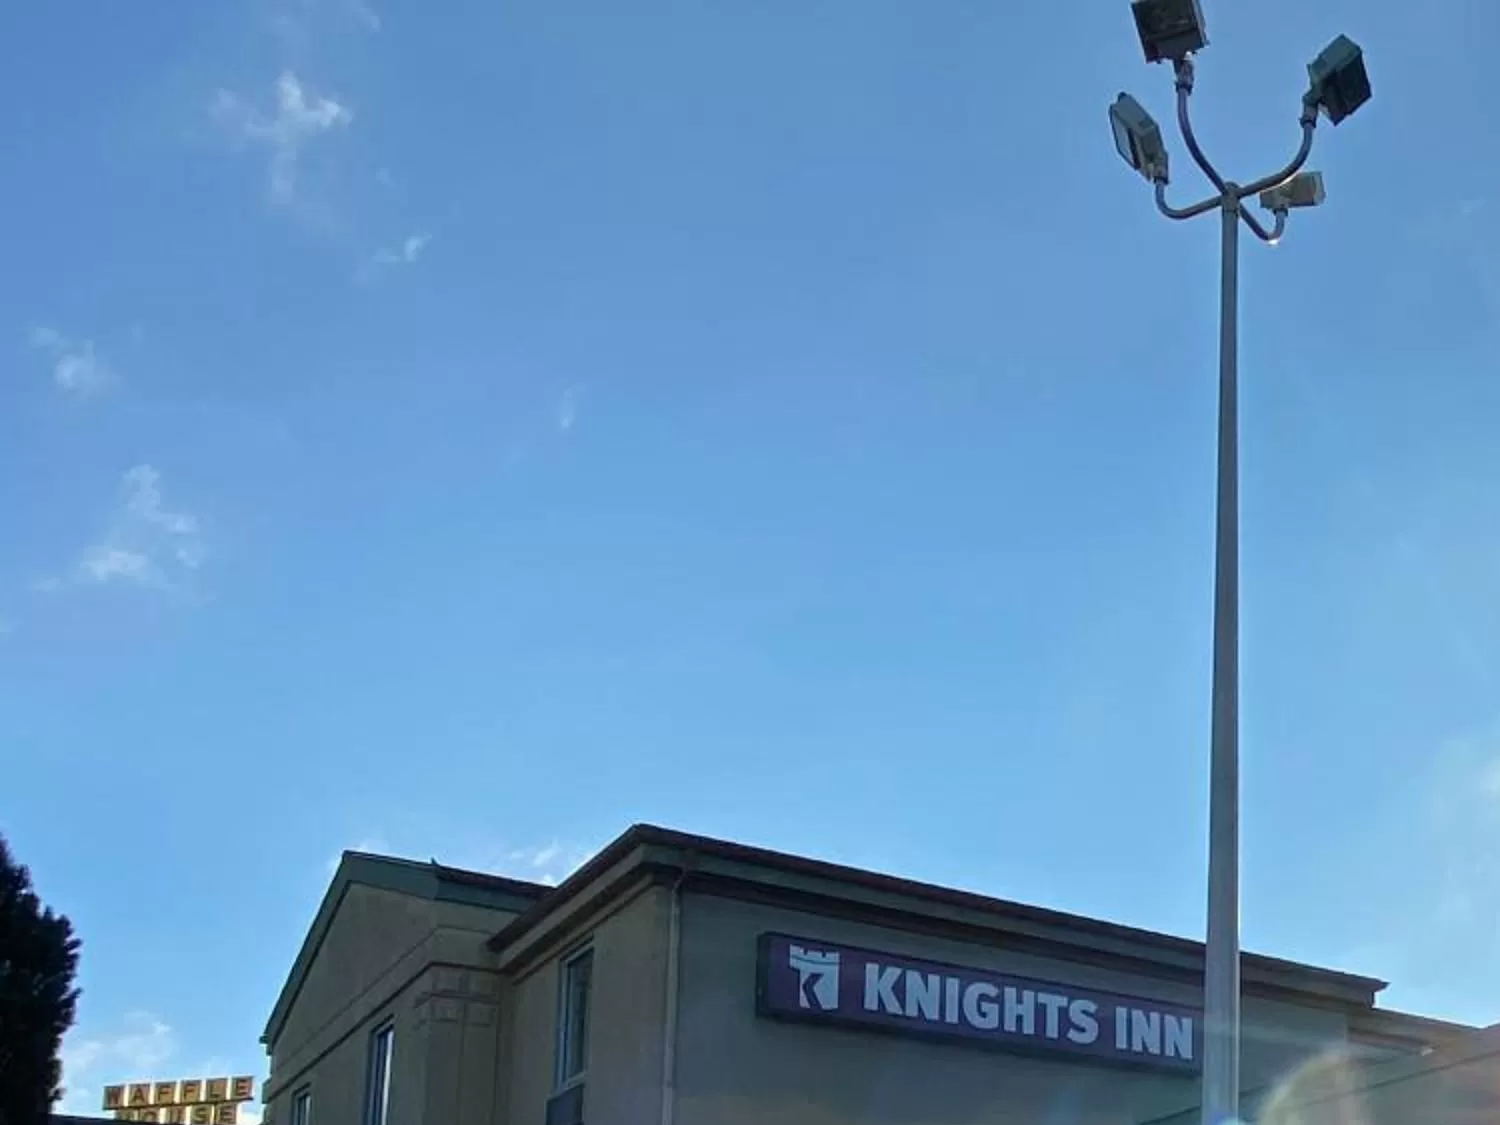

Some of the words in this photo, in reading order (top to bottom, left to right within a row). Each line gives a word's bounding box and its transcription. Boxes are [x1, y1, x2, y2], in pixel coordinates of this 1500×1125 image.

[863, 962, 1099, 1045] KNIGHTS
[1115, 1006, 1194, 1060] INN
[106, 1078, 251, 1107] WAFFLE
